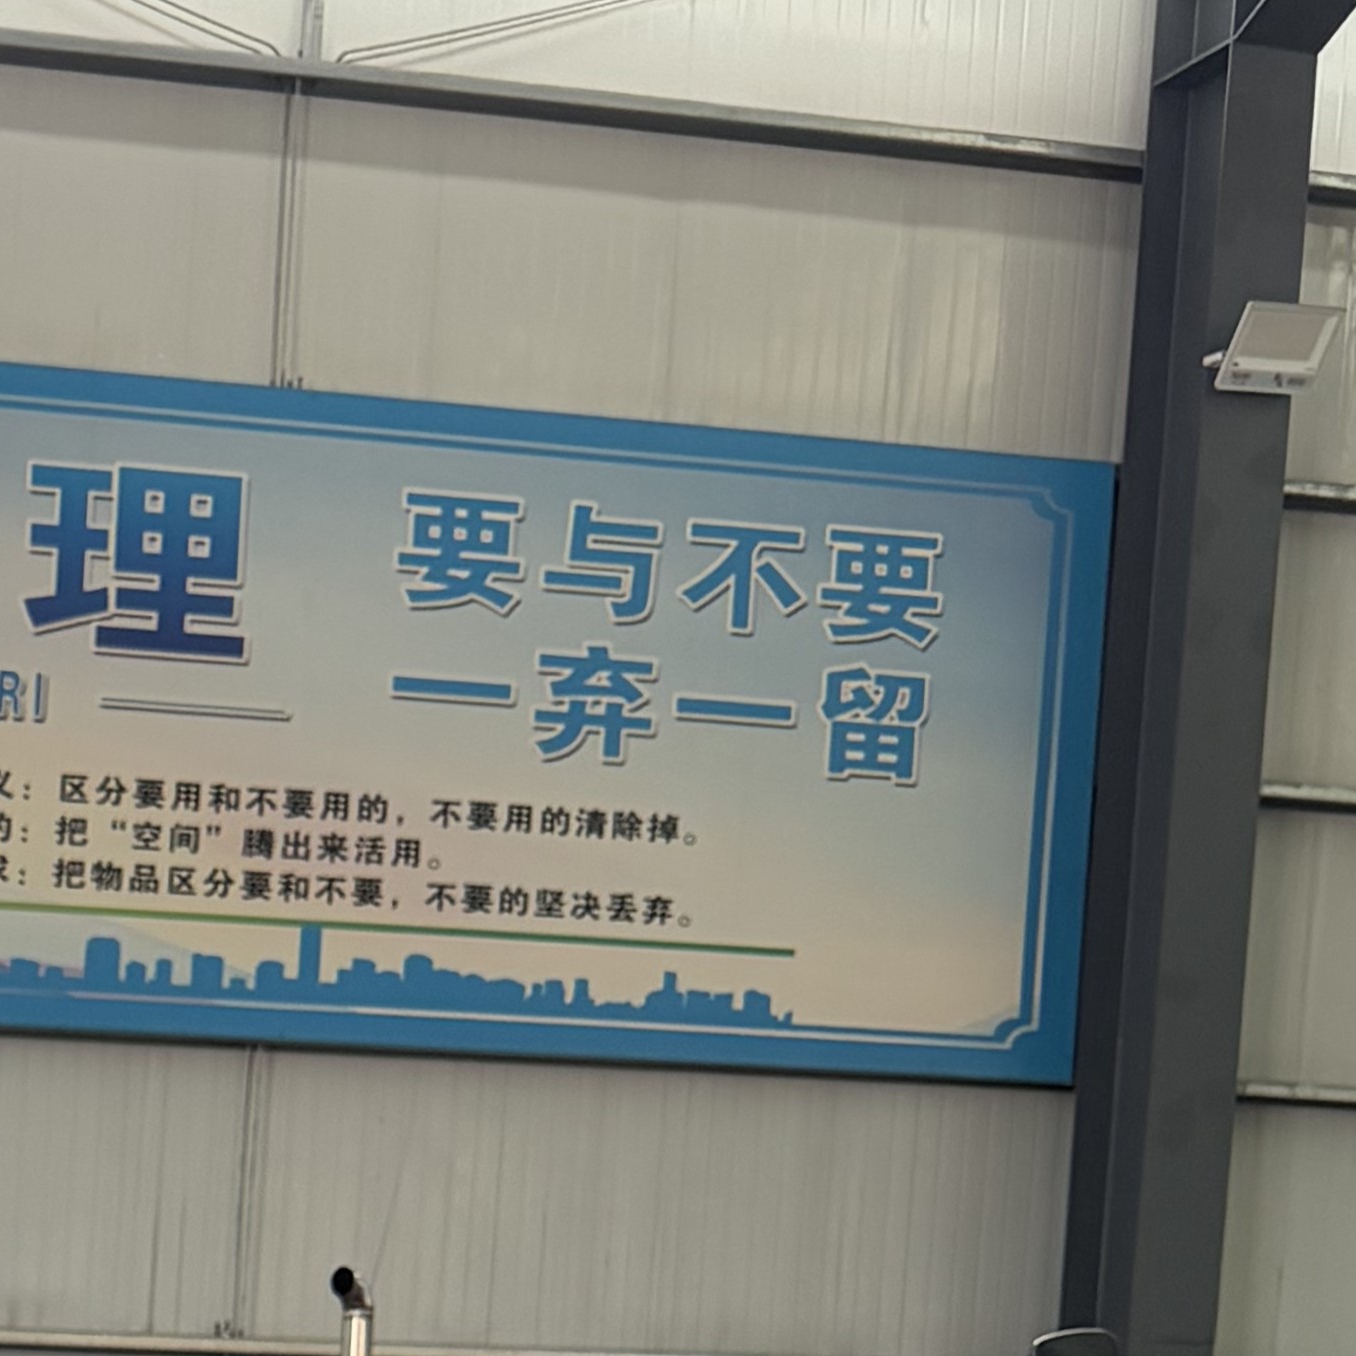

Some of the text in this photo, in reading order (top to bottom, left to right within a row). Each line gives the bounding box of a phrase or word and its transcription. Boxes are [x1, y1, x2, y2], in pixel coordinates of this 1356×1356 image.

[395, 487, 944, 649] 要与不要
[389, 641, 931, 787] 一弃一留
